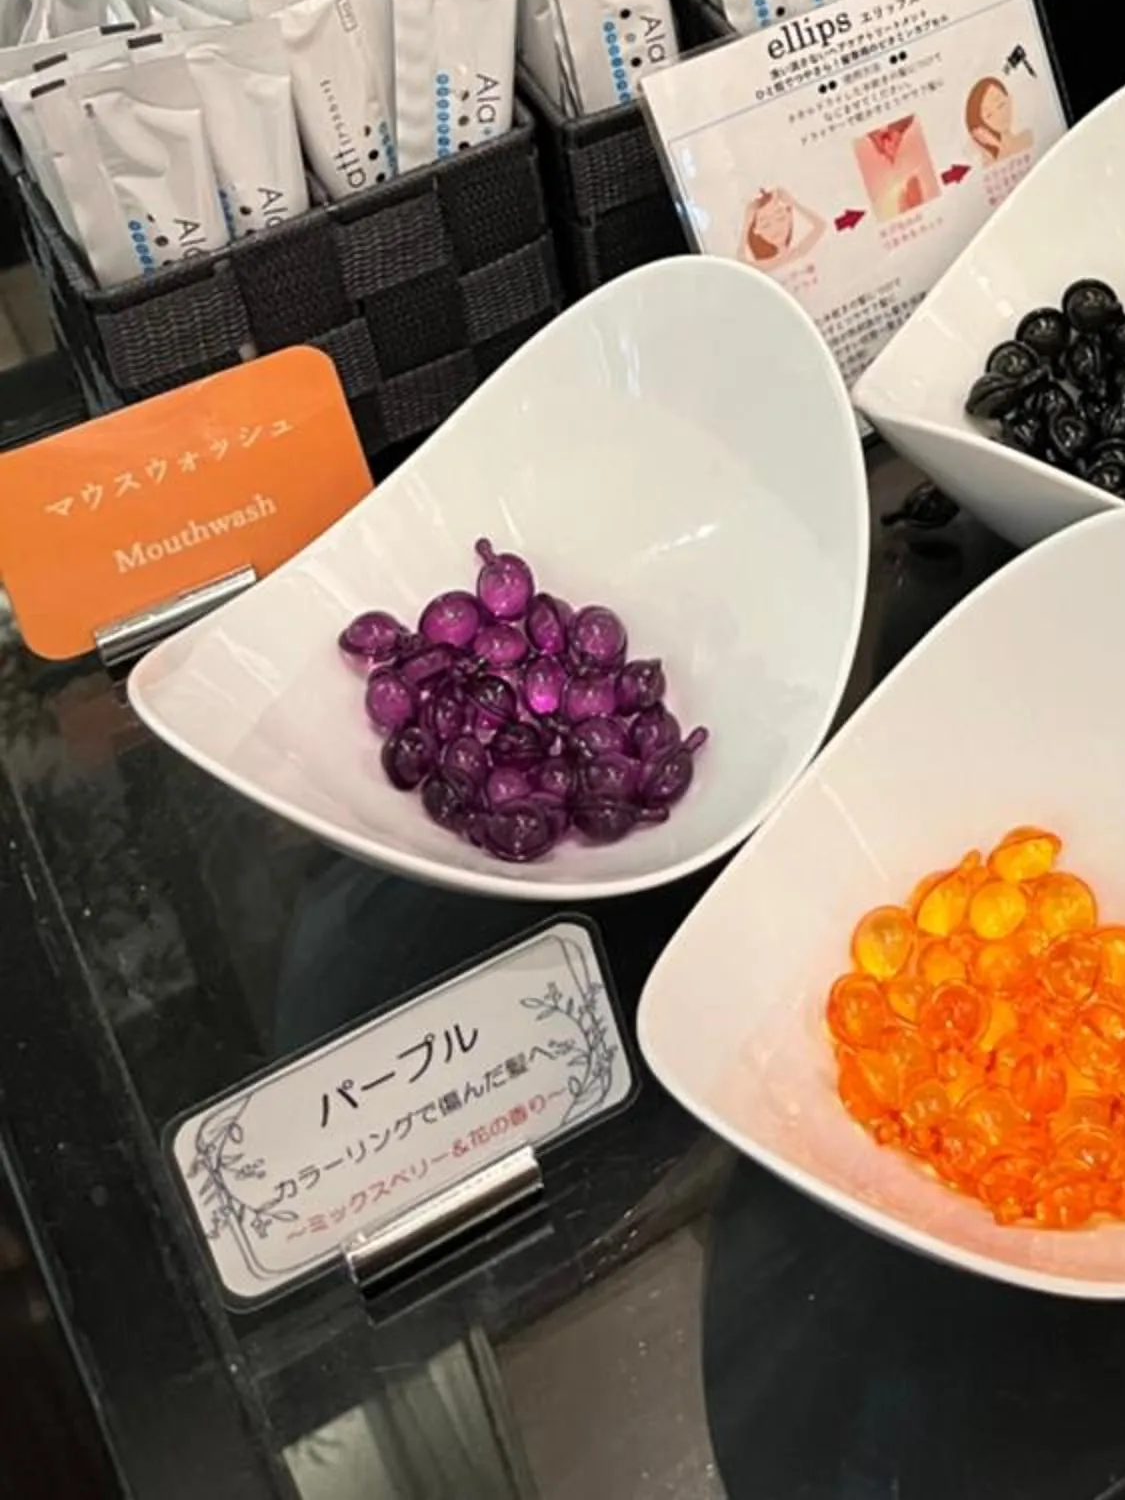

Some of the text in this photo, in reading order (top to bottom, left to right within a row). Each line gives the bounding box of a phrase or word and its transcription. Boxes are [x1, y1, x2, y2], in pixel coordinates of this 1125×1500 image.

[767, 8, 853, 60] ellips
[44, 419, 293, 517] マウスウォッシュ
[112, 493, 277, 573] Mouthwash
[274, 1045, 554, 1201] カラーリングで傷んだ髪へ
[320, 1023, 478, 1128] パープル
